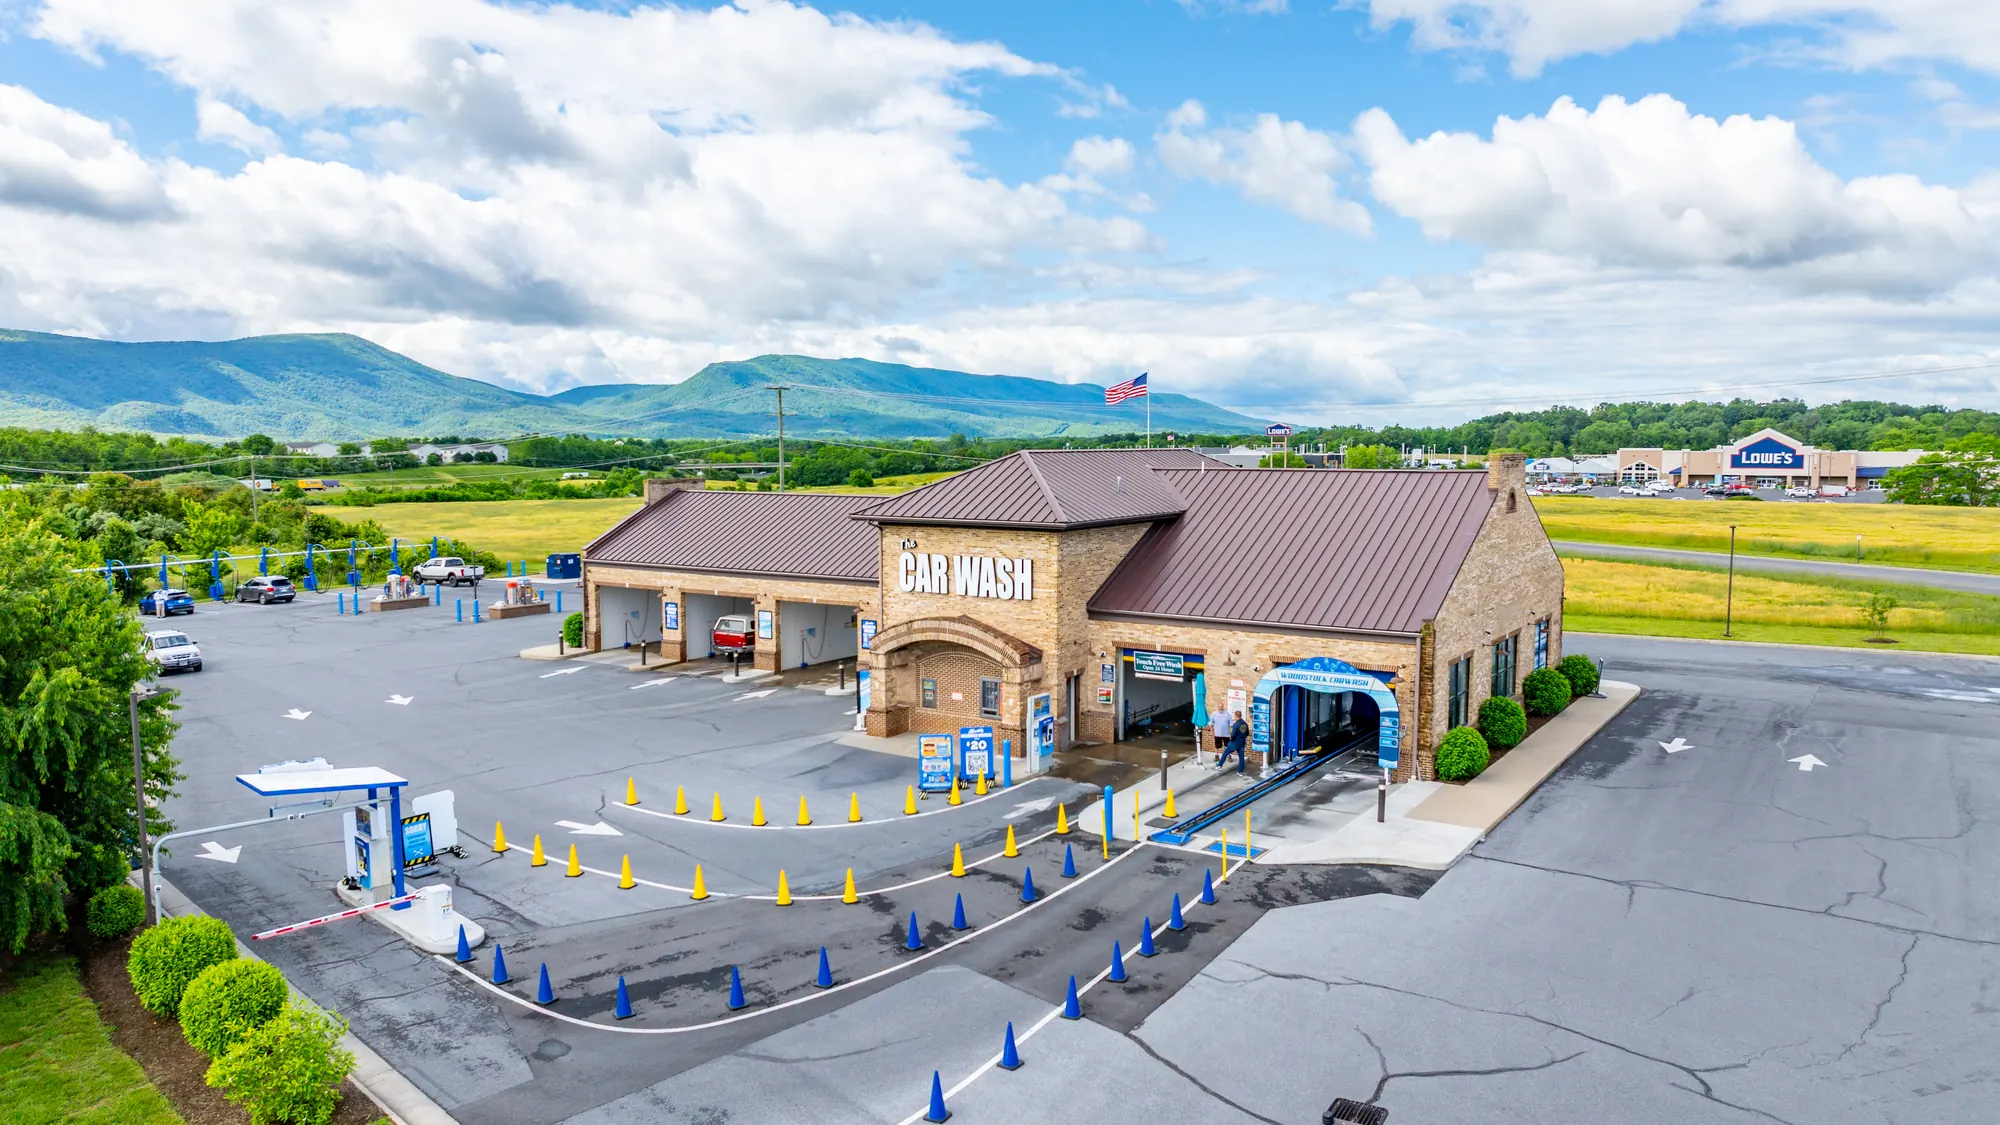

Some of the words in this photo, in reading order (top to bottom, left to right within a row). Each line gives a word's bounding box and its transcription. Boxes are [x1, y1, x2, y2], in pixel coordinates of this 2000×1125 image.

[1742, 452, 1794, 464] LOWE'S
[899, 538, 918, 551] The
[898, 551, 949, 595] CAR
[953, 555, 1033, 601] WASH
[1152, 659, 1165, 667] Free
[1280, 672, 1327, 683] WOODSTOCK
[1329, 676, 1369, 687] CARWASH
[404, 822, 426, 834] SORRY
